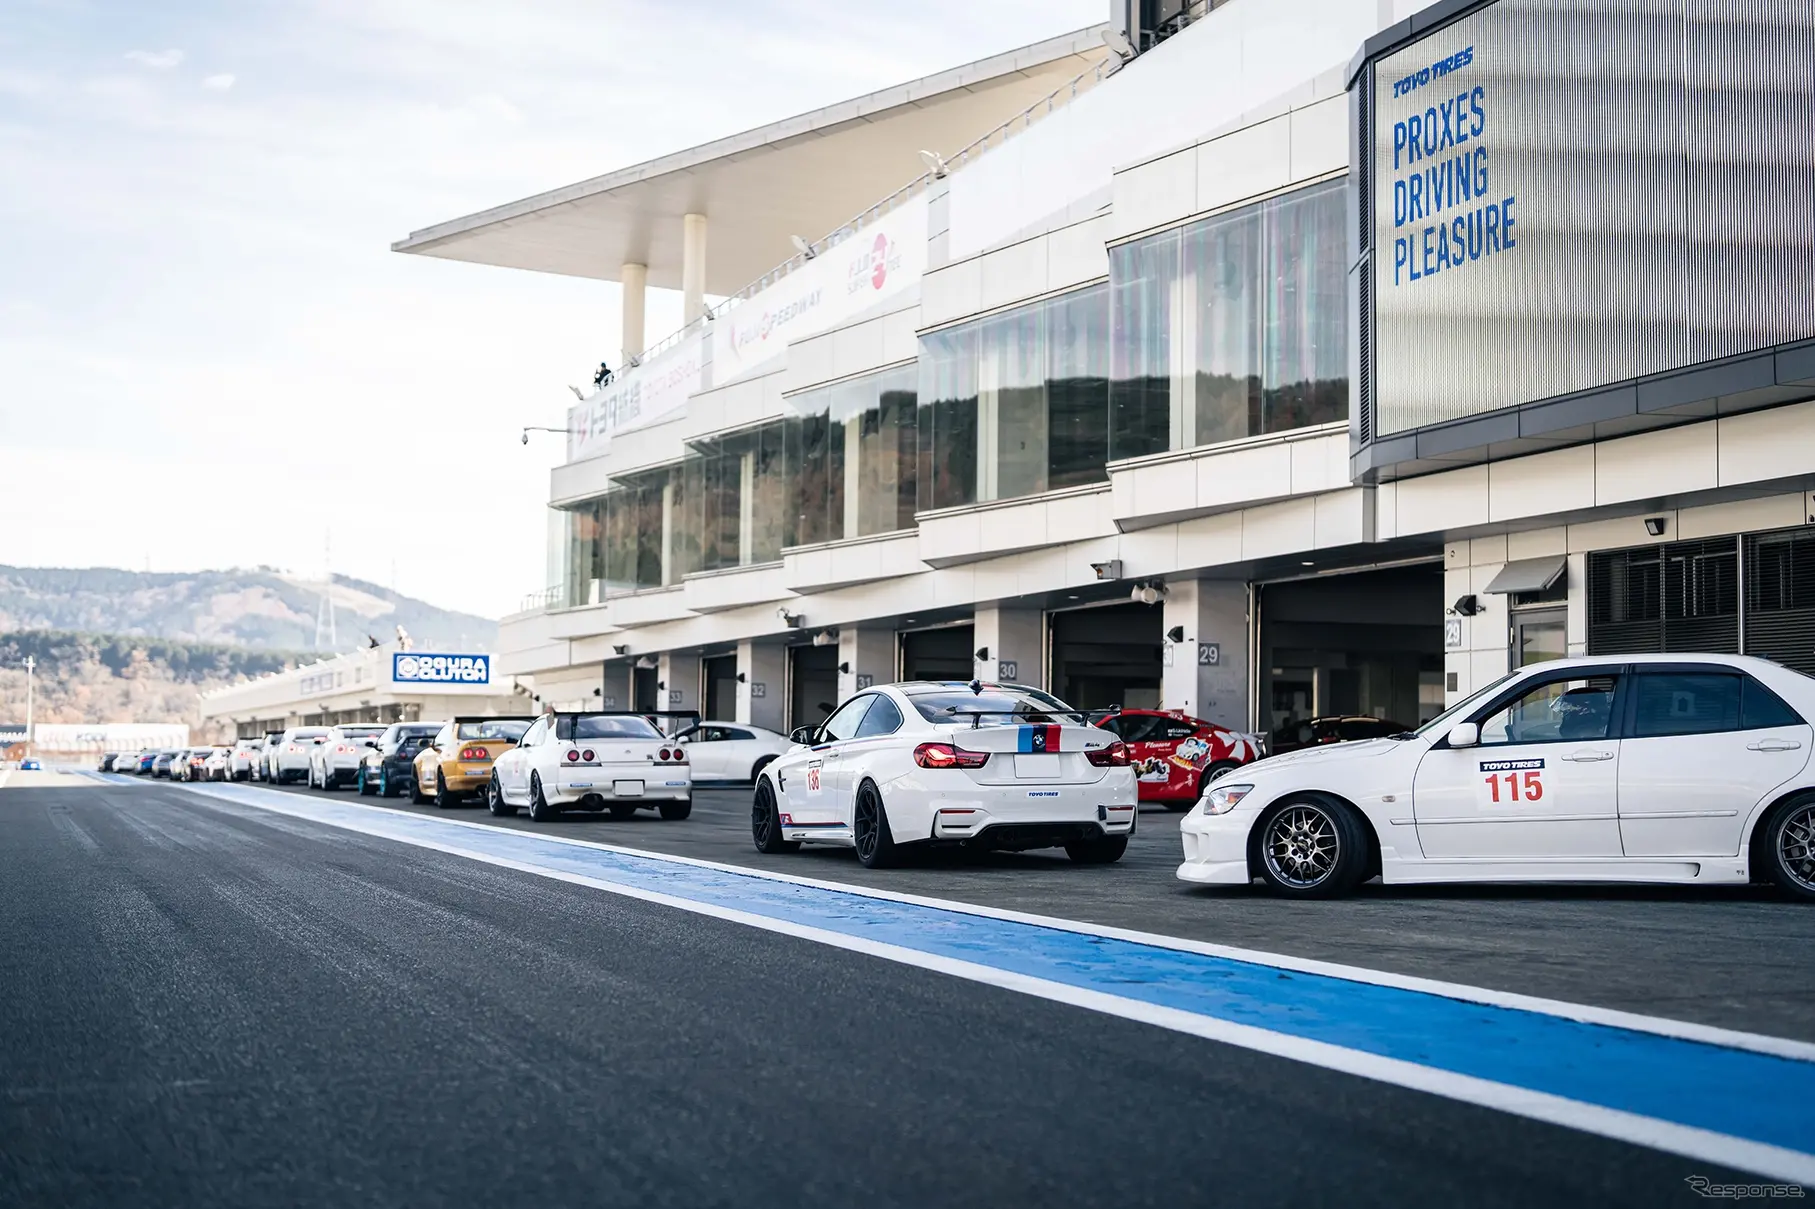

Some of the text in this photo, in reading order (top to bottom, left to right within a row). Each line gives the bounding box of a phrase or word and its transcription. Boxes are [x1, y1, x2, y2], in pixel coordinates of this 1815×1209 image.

[1394, 45, 1473, 98] TOYO TIRES
[1394, 85, 1485, 170] PROXES
[1394, 146, 1487, 228] DRIVING
[1394, 197, 1516, 286] PLEASURE
[1446, 622, 1460, 643] 29
[1200, 645, 1218, 664] 29
[1000, 663, 1016, 678] 30
[752, 684, 764, 696] 32
[858, 676, 871, 688] 31
[808, 769, 819, 791] 136
[1485, 771, 1543, 803] 115
